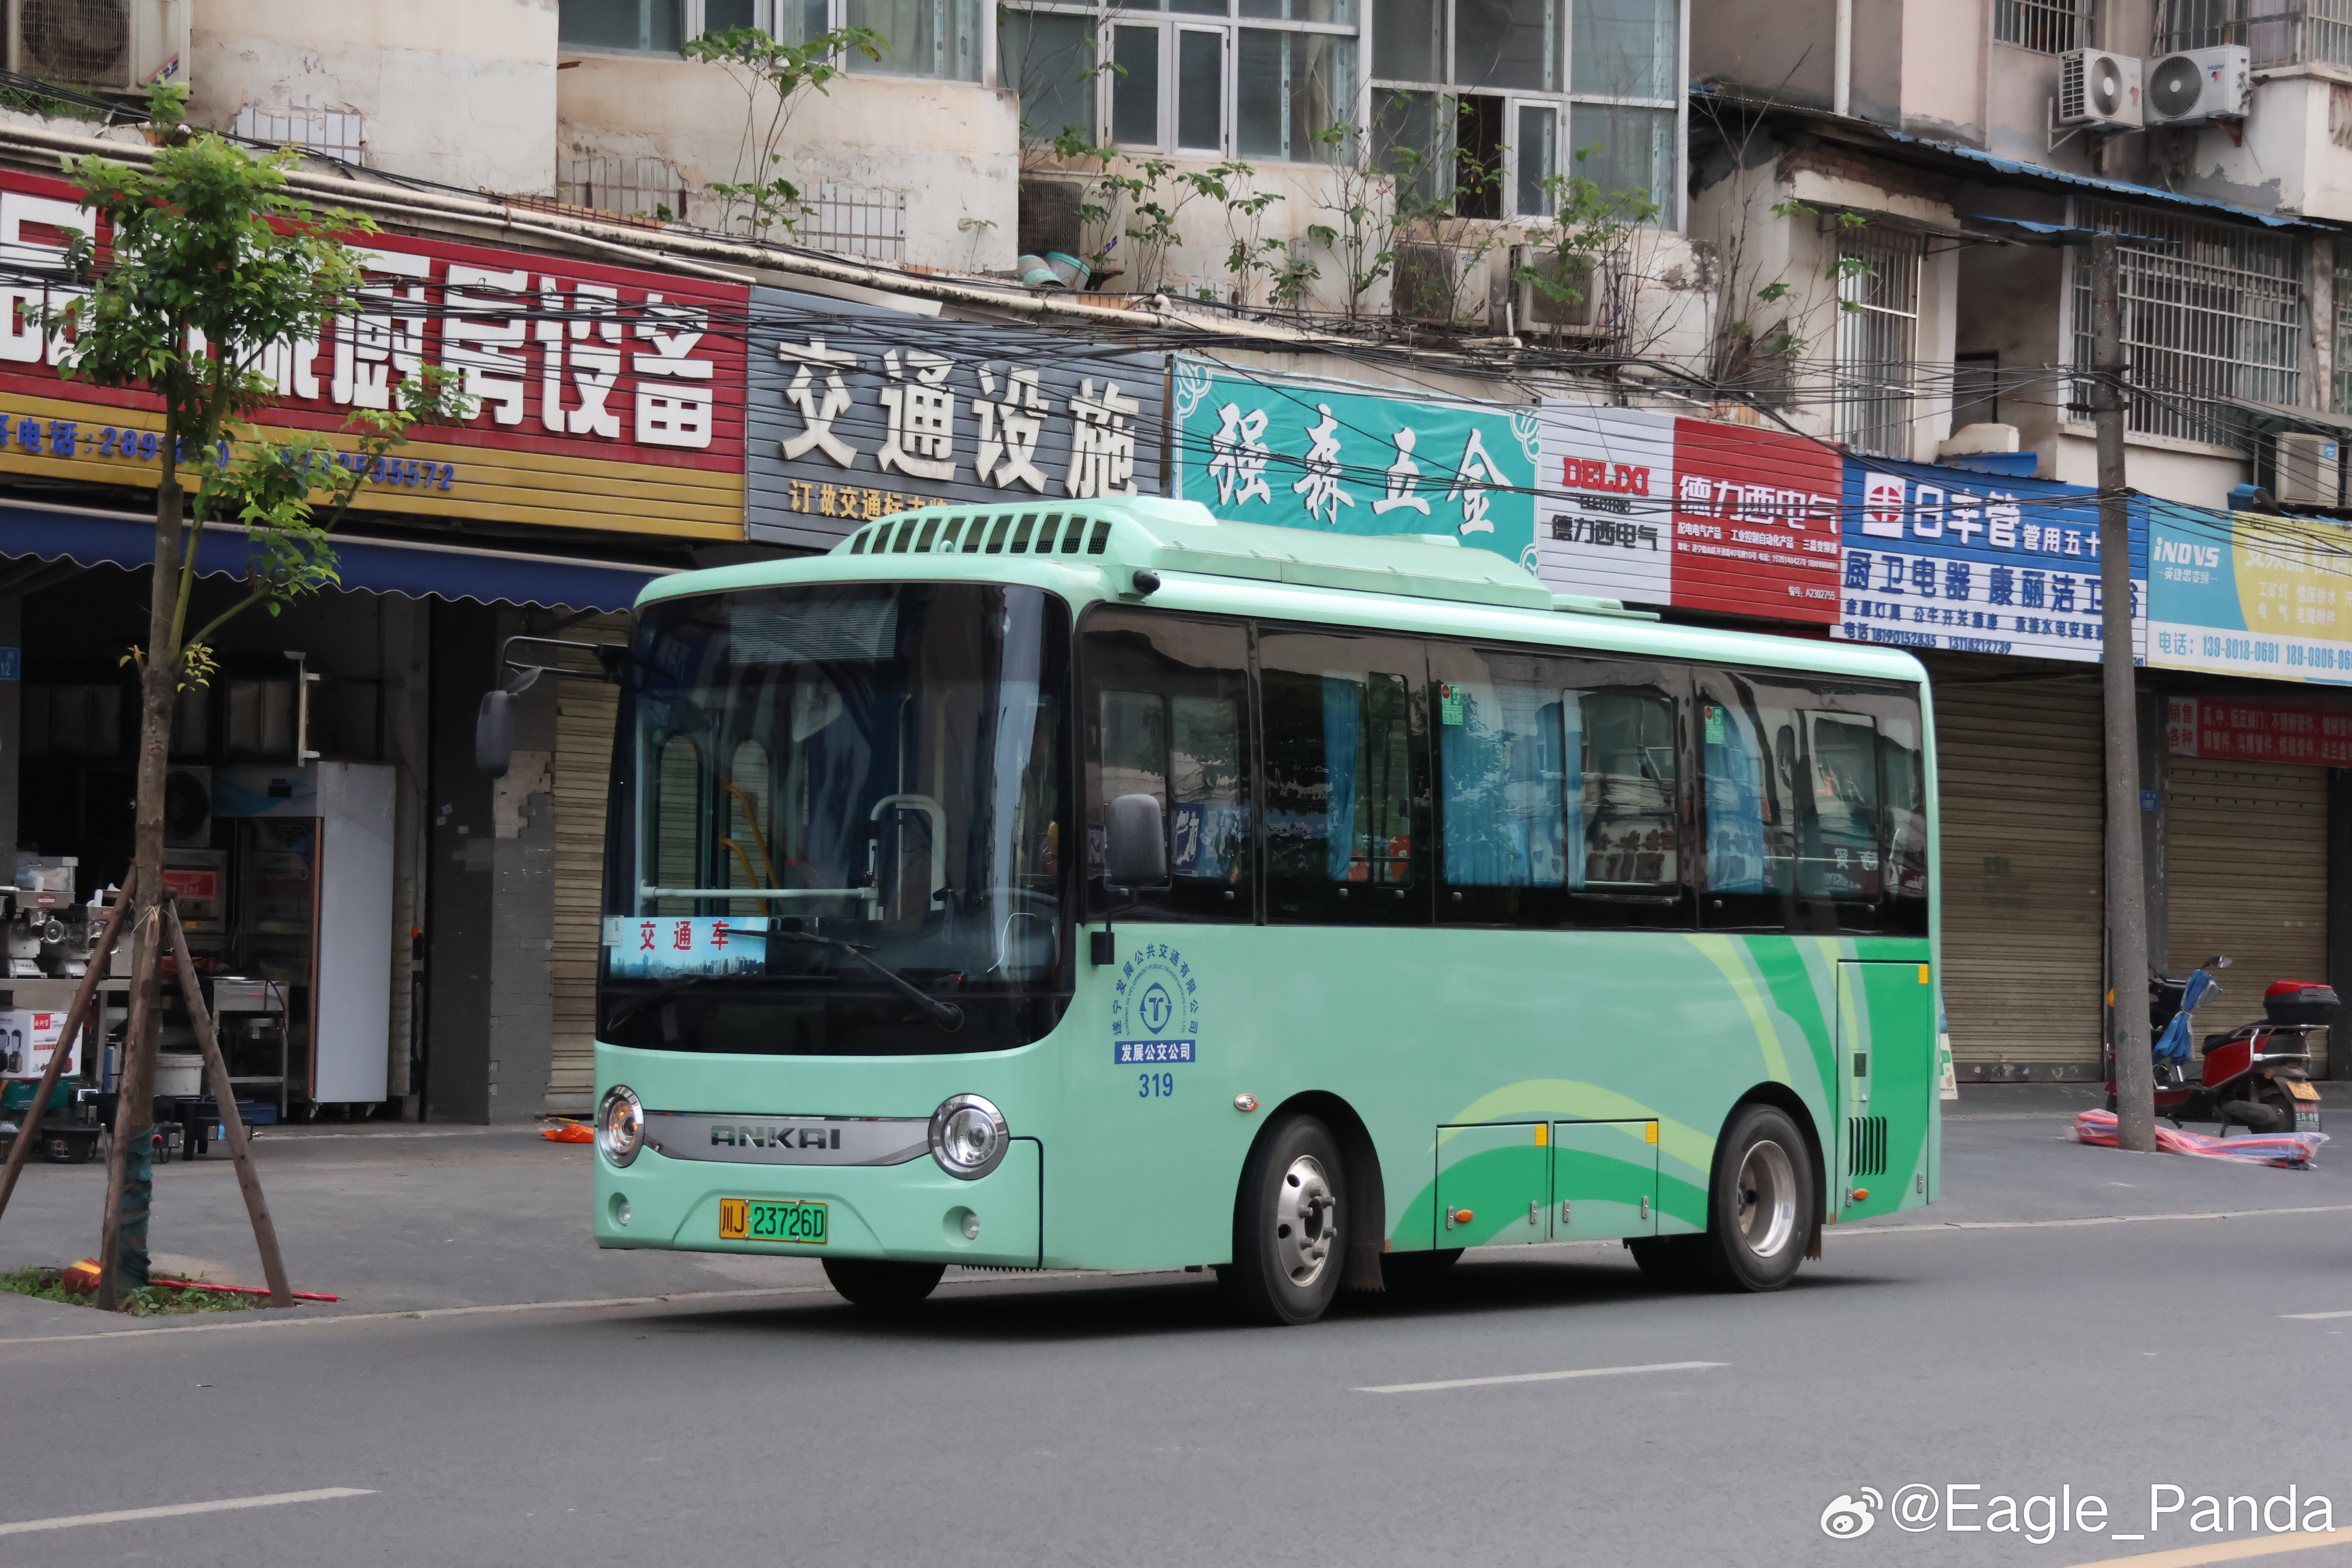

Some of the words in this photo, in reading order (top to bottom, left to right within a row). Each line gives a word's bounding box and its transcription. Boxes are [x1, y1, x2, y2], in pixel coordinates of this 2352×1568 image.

[0, 192, 713, 448] 品厨房设备
[778, 336, 1140, 498] 交通设施
[1206, 403, 1514, 536] 强森五金
[1563, 457, 1650, 496] DELIXI
[1679, 474, 1838, 534] 德力西电气
[1913, 484, 2020, 548] 日丰管
[1551, 514, 1658, 551] 德力西电气
[1677, 521, 1721, 539] 配电电气产品
[1730, 529, 1794, 549] 工业控制自动化产品
[1802, 539, 1838, 555] 三晶变频器
[2245, 532, 2305, 573] 变频器
[2311, 539, 2352, 578] 软启
[1805, 588, 1836, 601] A2302755
[1844, 551, 1970, 601] 厨卫电器
[1844, 621, 1869, 640] 电话
[2158, 631, 2194, 656] 电话：
[2203, 635, 2279, 663] 139-8018-0691
[2286, 644, 2352, 671] 189-0906-06
[639, 919, 730, 952] 交通车
[1112, 943, 1199, 1036] 遂宁发展公共交通有限公司
[1121, 1043, 1190, 1062] 发展公交公司
[1139, 1072, 1173, 1098] 319
[711, 1125, 840, 1150] ANKAI
[722, 1205, 745, 1233] 川J
[754, 1206, 825, 1237] 23726D
